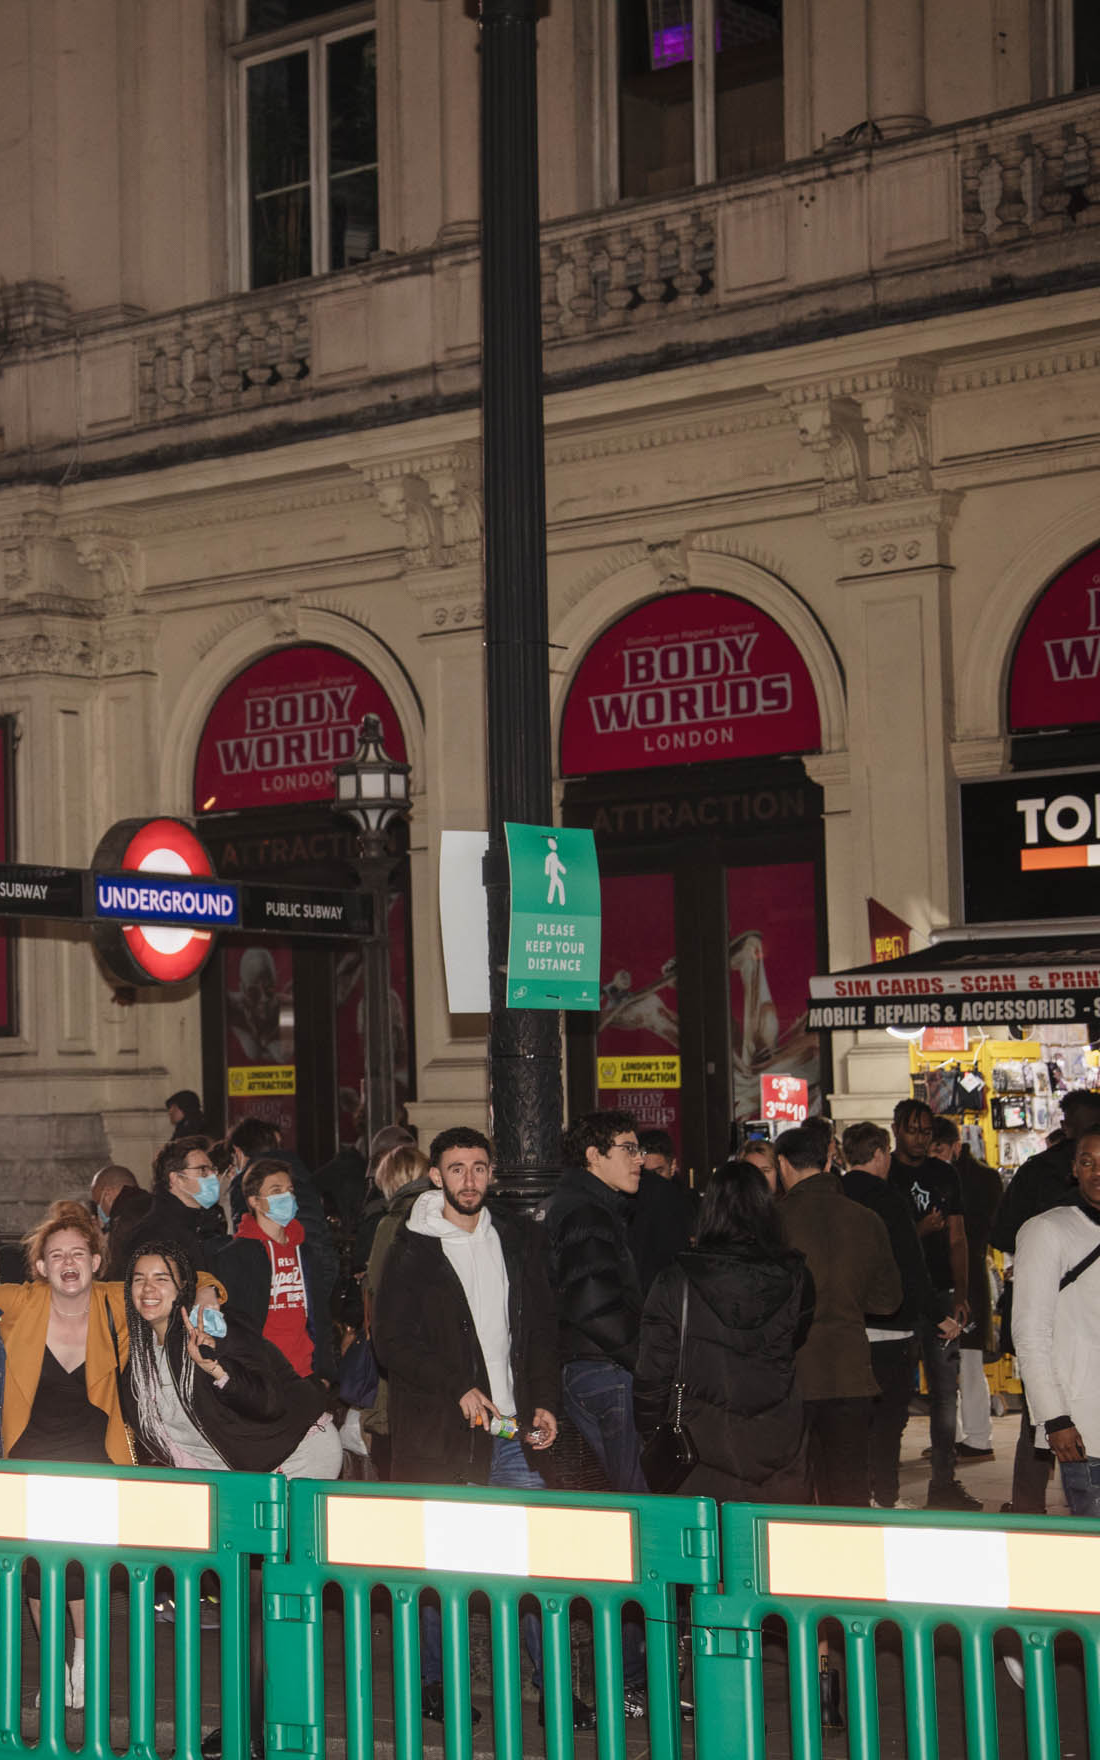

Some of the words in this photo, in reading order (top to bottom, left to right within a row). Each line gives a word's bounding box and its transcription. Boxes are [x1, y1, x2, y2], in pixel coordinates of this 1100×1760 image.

[623, 632, 760, 688] BODY
[245, 684, 357, 734] BODY
[588, 672, 793, 734] WORLDS
[216, 723, 364, 775] WORLD
[644, 727, 734, 752] LONDON
[262, 769, 335, 792] LONDON
[1016, 794, 1100, 845] TO
[0, 881, 48, 901] SUBWAY
[99, 885, 234, 917] UNDERGROUND
[265, 901, 301, 918] PUBLIC
[303, 904, 343, 921] SUBWAY
[537, 923, 576, 937] PLEASE
[526, 940, 552, 953] KEEP
[556, 941, 585, 955] YOUR
[527, 958, 581, 972] DISTANCE
[835, 977, 872, 997] SIM
[876, 975, 944, 995] CARDS
[960, 973, 1017, 993] SCAN
[1028, 974, 1044, 989] &
[1048, 968, 1100, 989] PRIN
[809, 1005, 867, 1027] MOBILE
[874, 1002, 941, 1024] REPAIRS
[944, 1004, 957, 1022] &
[961, 998, 1076, 1021] ACCESSORIES
[621, 1062, 659, 1071] LONDON'S
[662, 1062, 677, 1071] TOP
[621, 1072, 677, 1083] ATTRACTION
